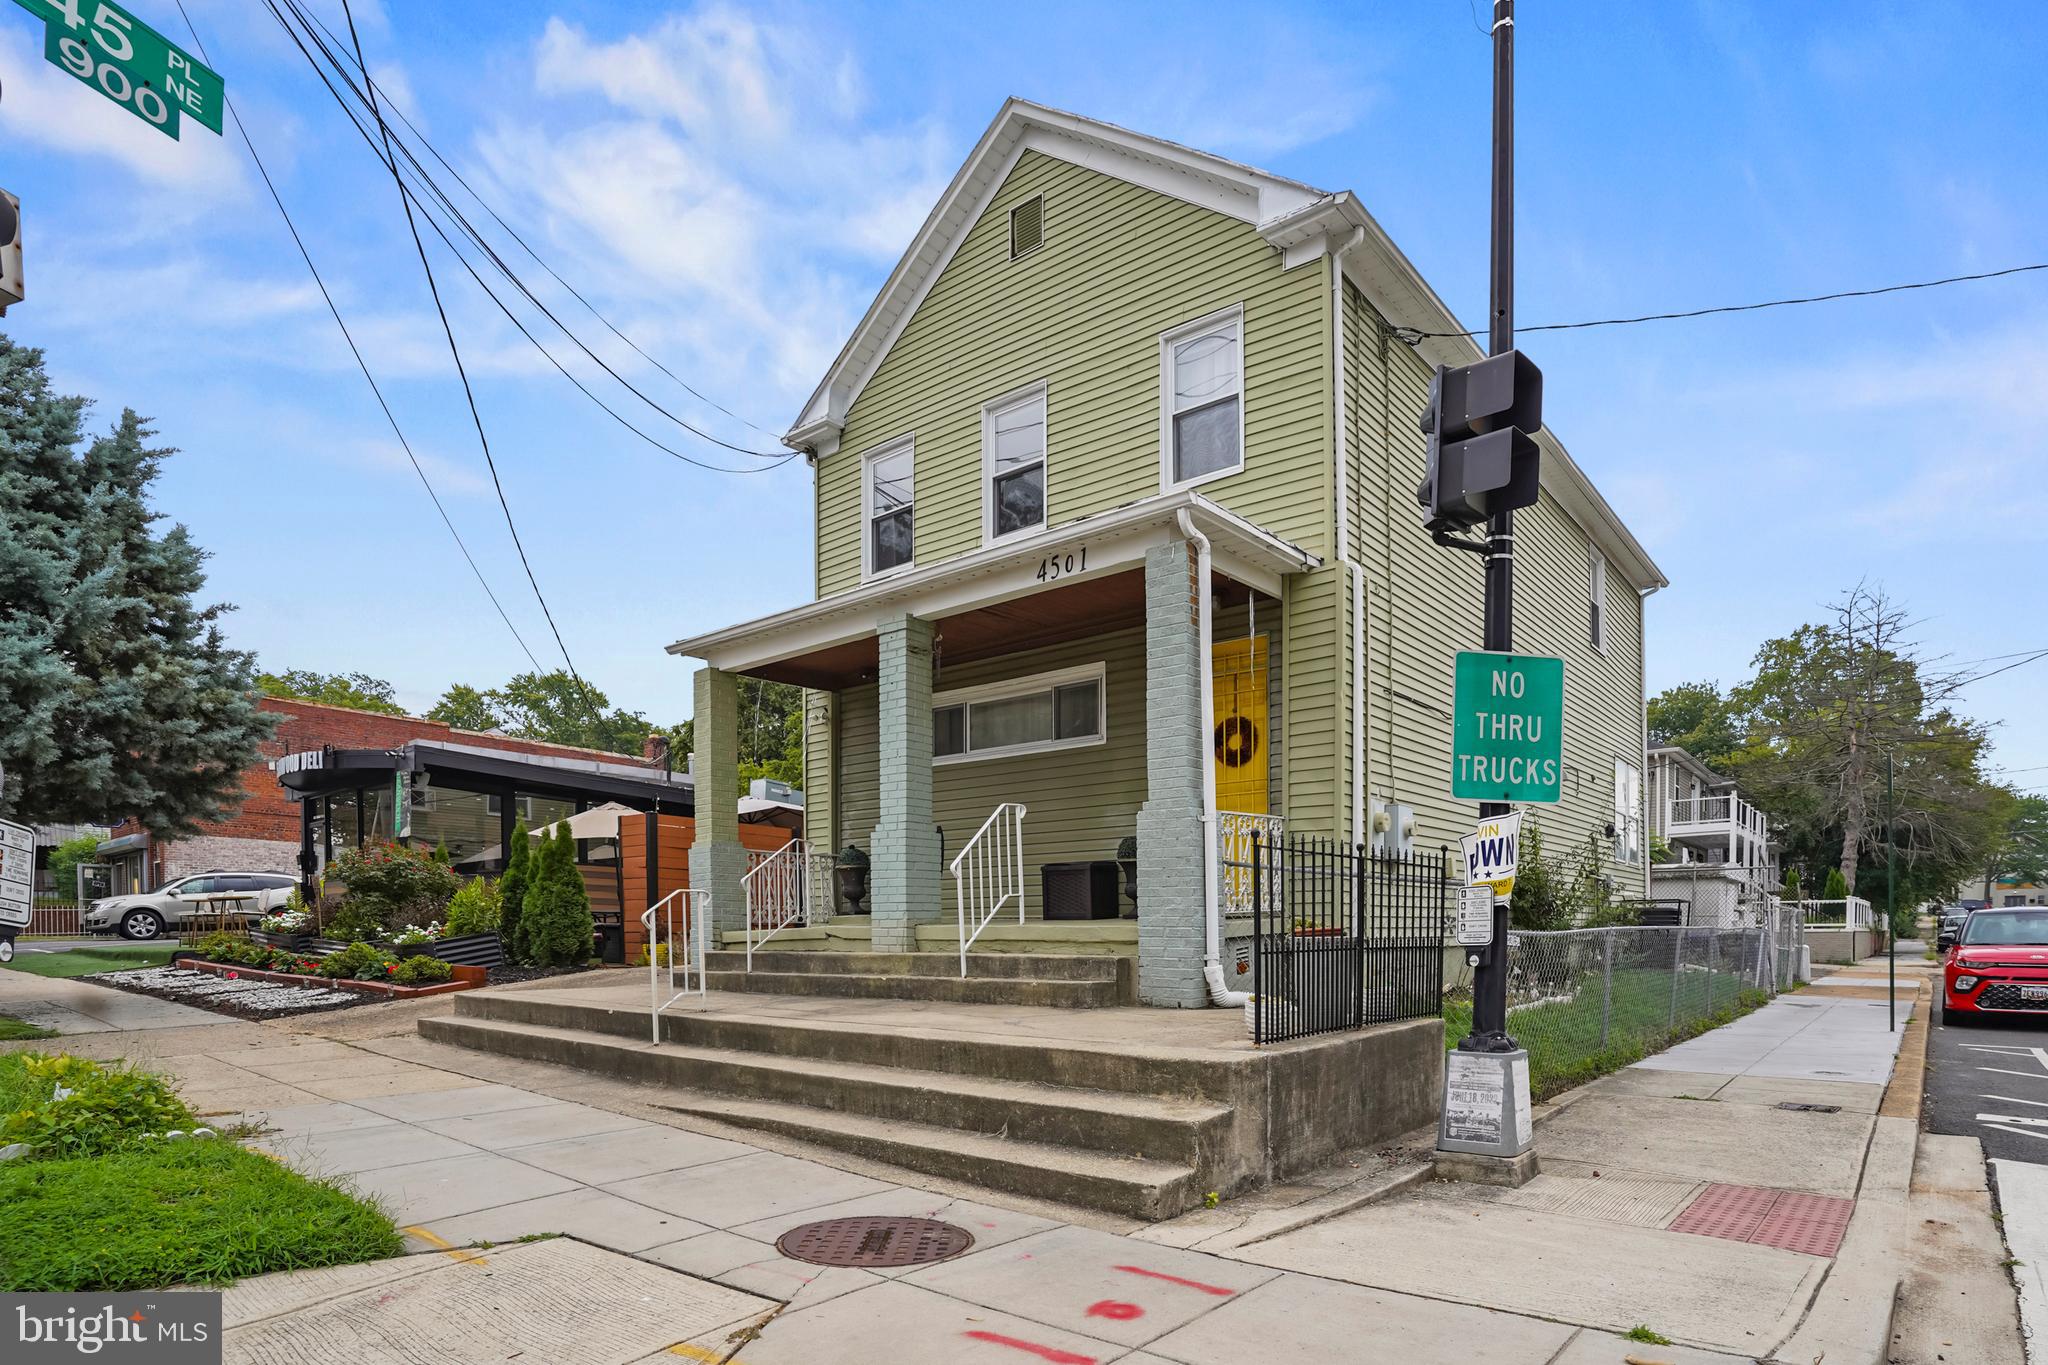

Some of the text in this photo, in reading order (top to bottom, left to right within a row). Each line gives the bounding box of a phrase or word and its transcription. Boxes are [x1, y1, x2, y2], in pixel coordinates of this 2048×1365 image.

[46, 0, 134, 61] 45
[59, 37, 168, 124] 900
[168, 49, 200, 87] PL
[166, 74, 202, 114] NE
[1037, 546, 1087, 582] 4501
[1491, 670, 1525, 699] NO
[1475, 711, 1542, 743] THRU
[301, 750, 323, 771] DELI
[1458, 754, 1556, 786] TRUCKS
[1477, 824, 1499, 838] VIN
